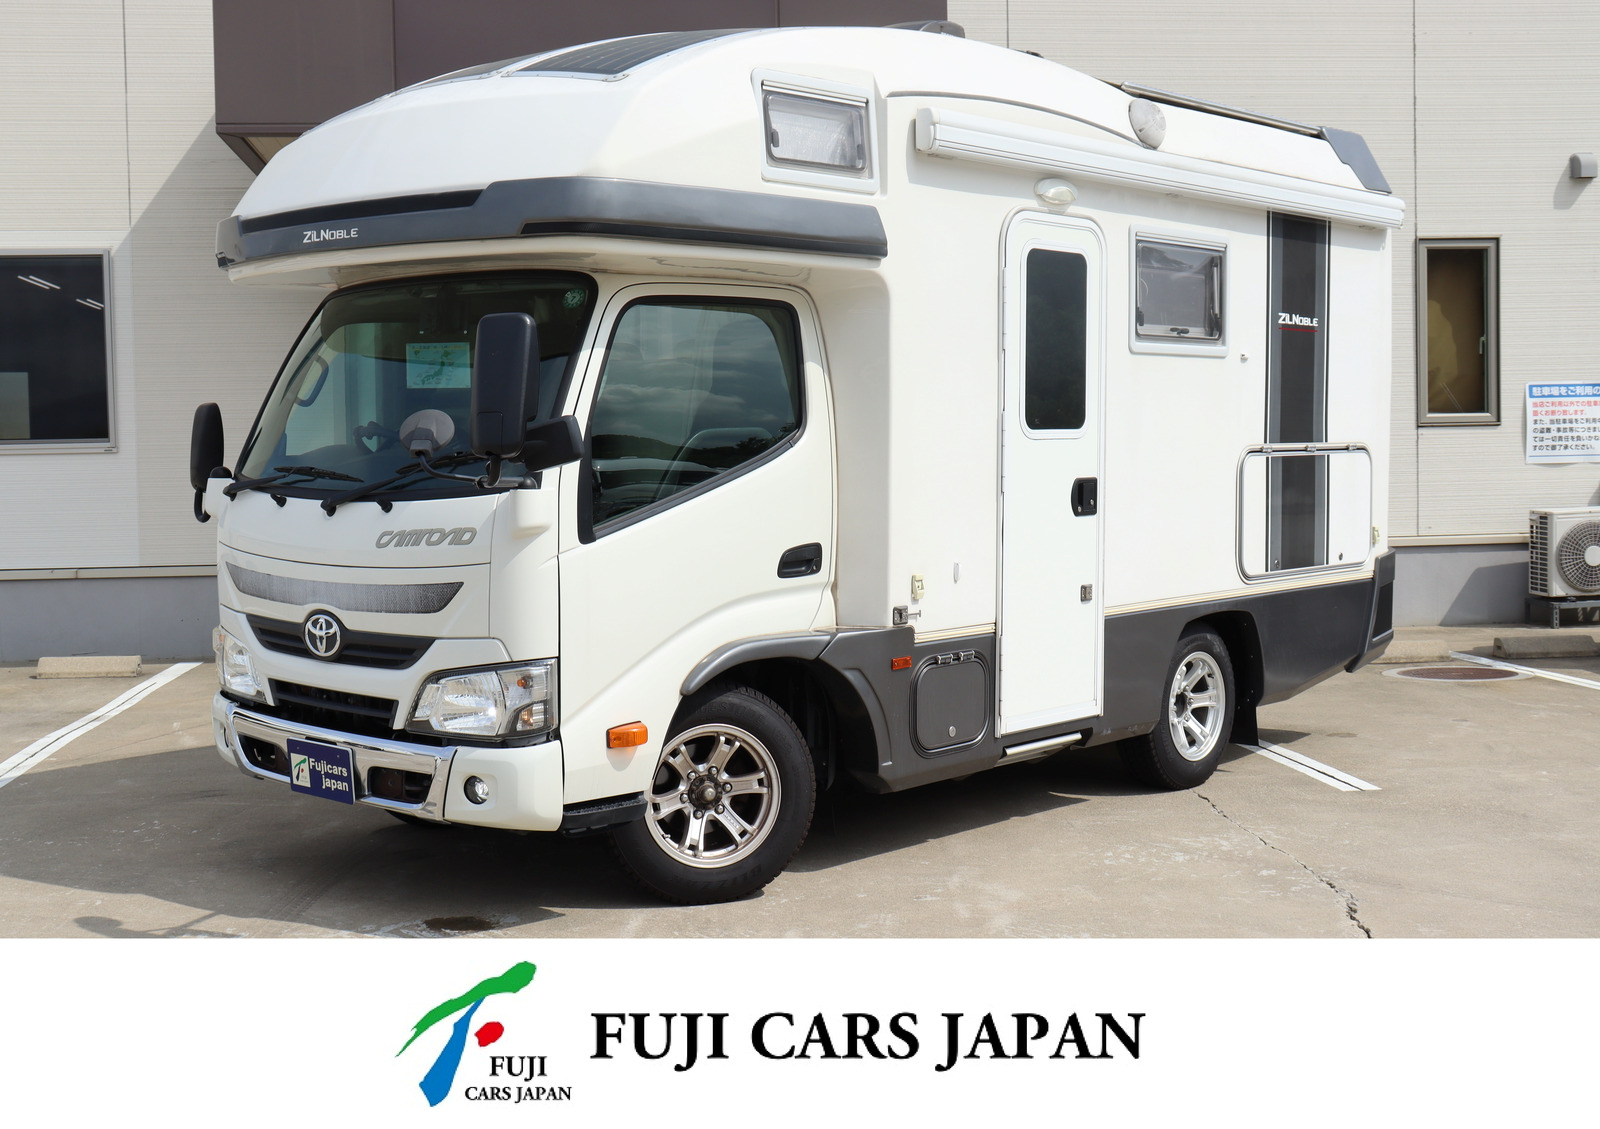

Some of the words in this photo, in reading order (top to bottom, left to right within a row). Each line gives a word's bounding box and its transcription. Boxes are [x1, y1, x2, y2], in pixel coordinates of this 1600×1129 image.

[1532, 400, 1600, 408] 当店ご利用以外での駐車
[309, 758, 348, 777] Fujicars
[322, 775, 349, 792] japan
